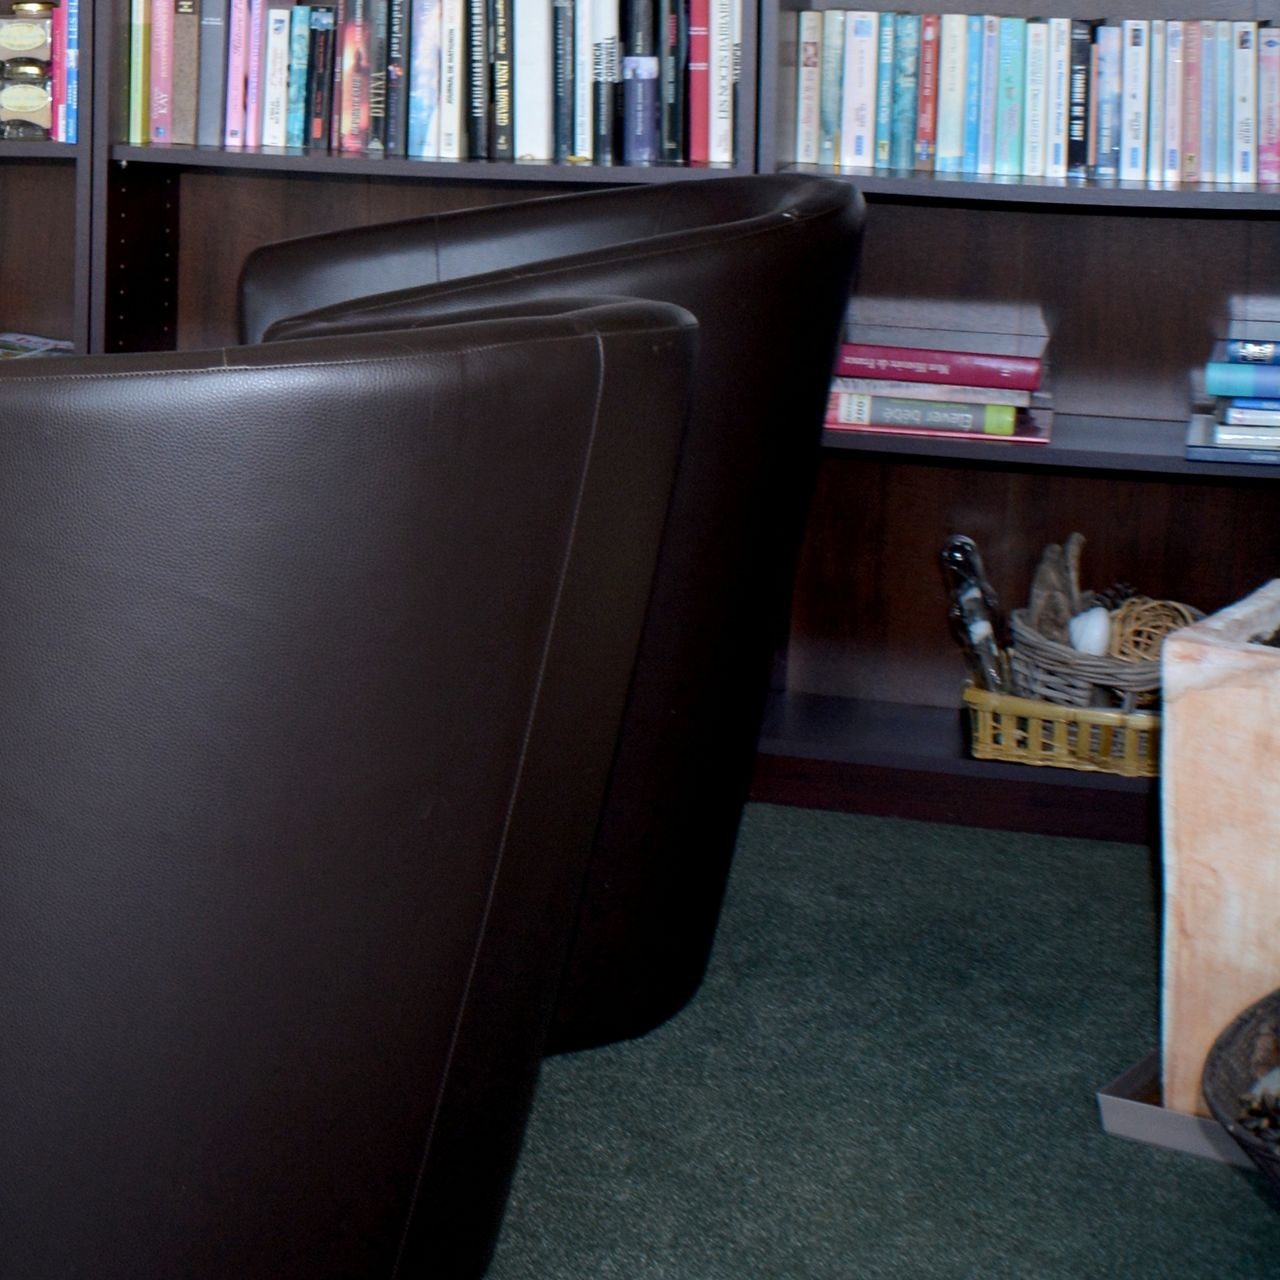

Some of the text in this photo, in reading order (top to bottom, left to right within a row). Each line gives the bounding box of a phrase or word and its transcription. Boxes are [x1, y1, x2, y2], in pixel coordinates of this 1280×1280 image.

[68, 17, 78, 39] LES
[881, 26, 892, 64] HEYER
[445, 28, 454, 105] JOURNAL DE MATIGNON
[718, 45, 729, 87] NOCES
[159, 92, 168, 114] KAY
[370, 71, 385, 117] DIVINA
[495, 60, 508, 127] LINDA HOWARD
[718, 89, 729, 110] LES
